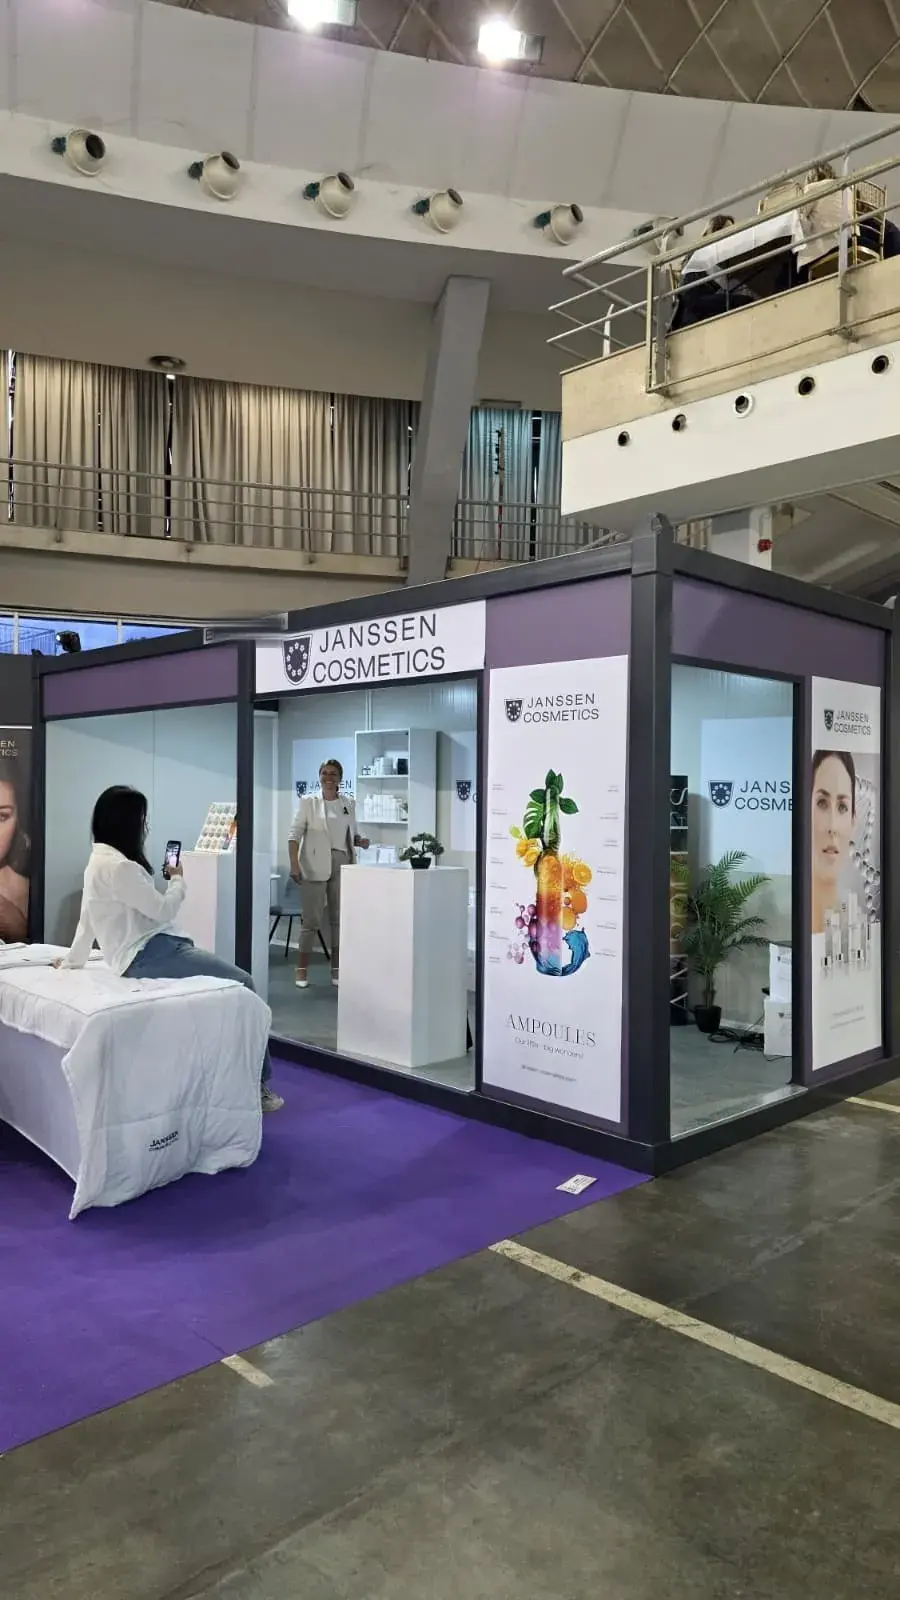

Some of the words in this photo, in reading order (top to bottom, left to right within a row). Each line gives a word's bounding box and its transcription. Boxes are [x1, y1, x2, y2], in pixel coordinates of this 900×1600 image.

[319, 613, 437, 654] JANSSEN
[312, 646, 446, 684] COSMETICS
[527, 693, 596, 709] JANSSEN
[523, 708, 600, 723] COSMETICS
[834, 709, 870, 723] JANSSEN
[833, 721, 872, 736] COSMETICS
[0, 740, 16, 748] EN
[505, 1013, 597, 1048] AMPOULES
